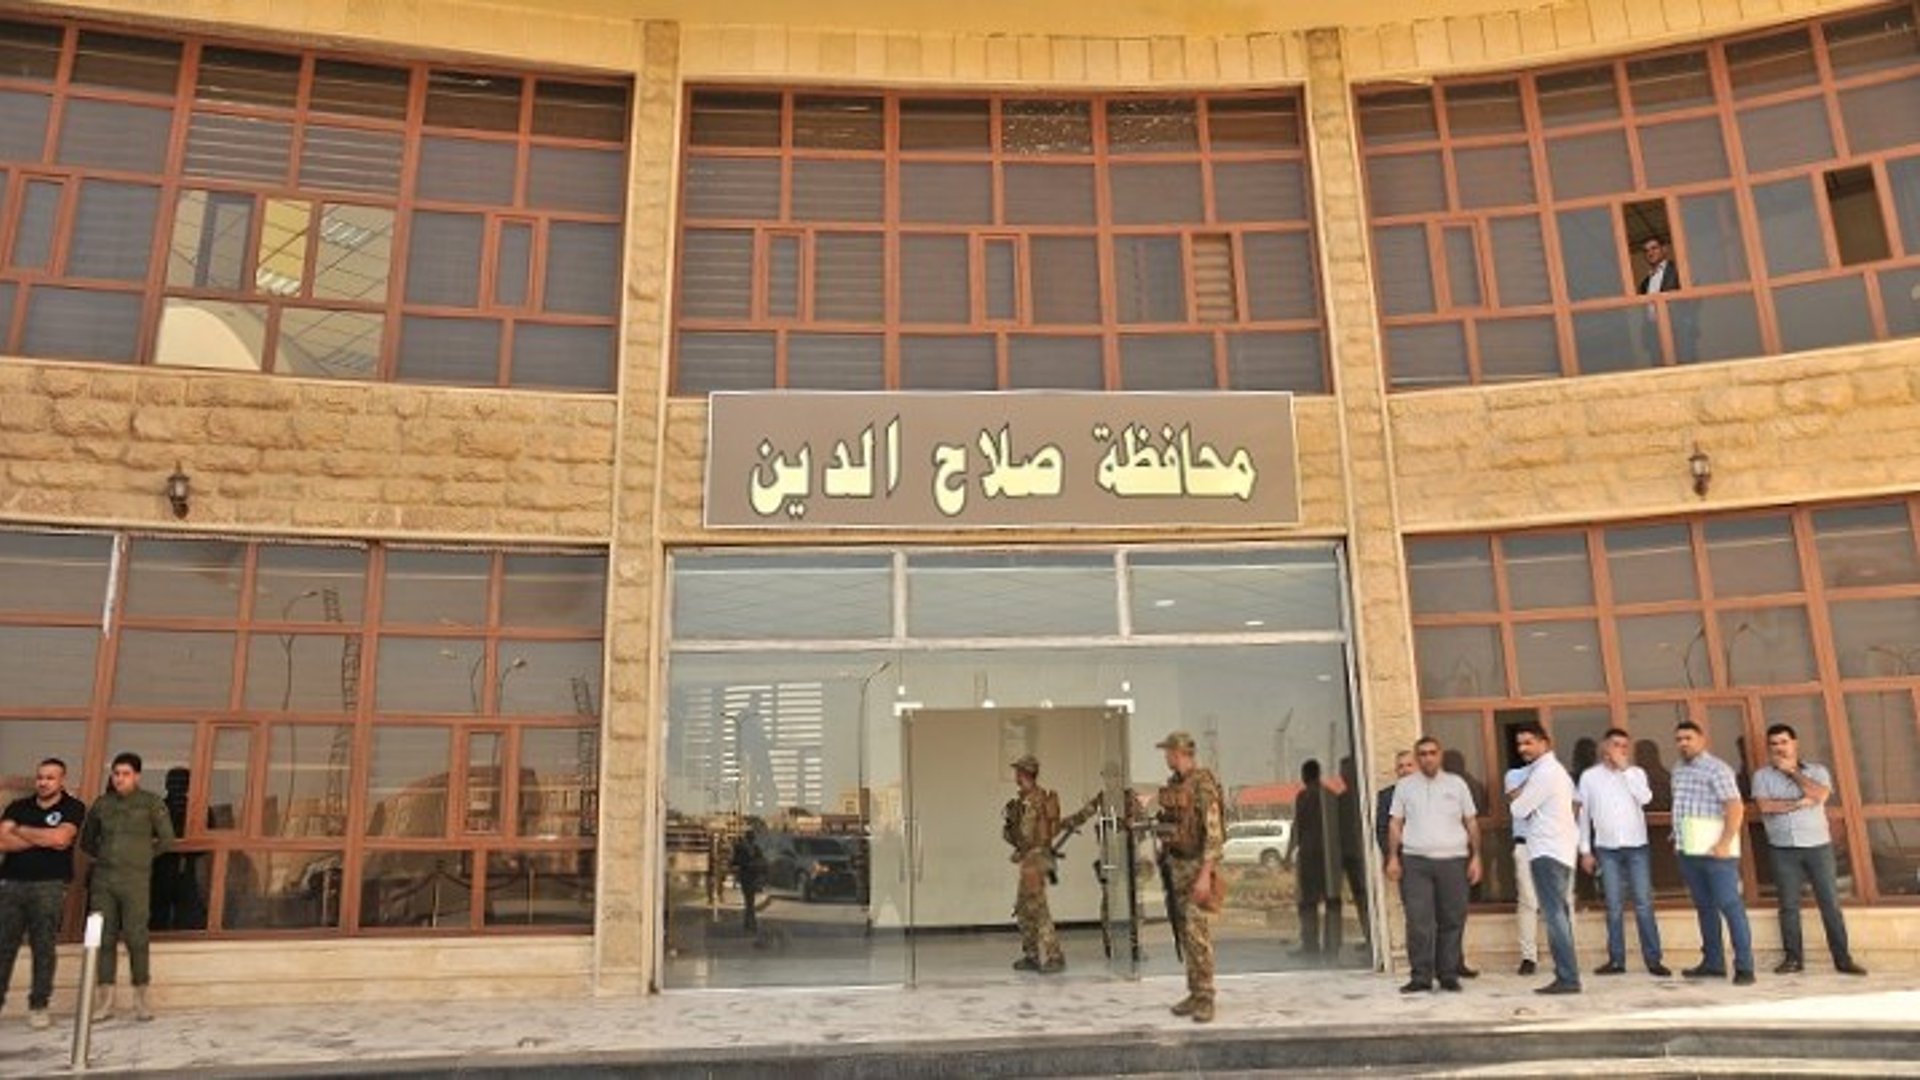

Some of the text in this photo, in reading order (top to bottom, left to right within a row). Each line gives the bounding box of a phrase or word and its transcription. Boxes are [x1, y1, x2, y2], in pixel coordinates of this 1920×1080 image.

[749, 415, 1258, 519] محافظة صلاح الدين
